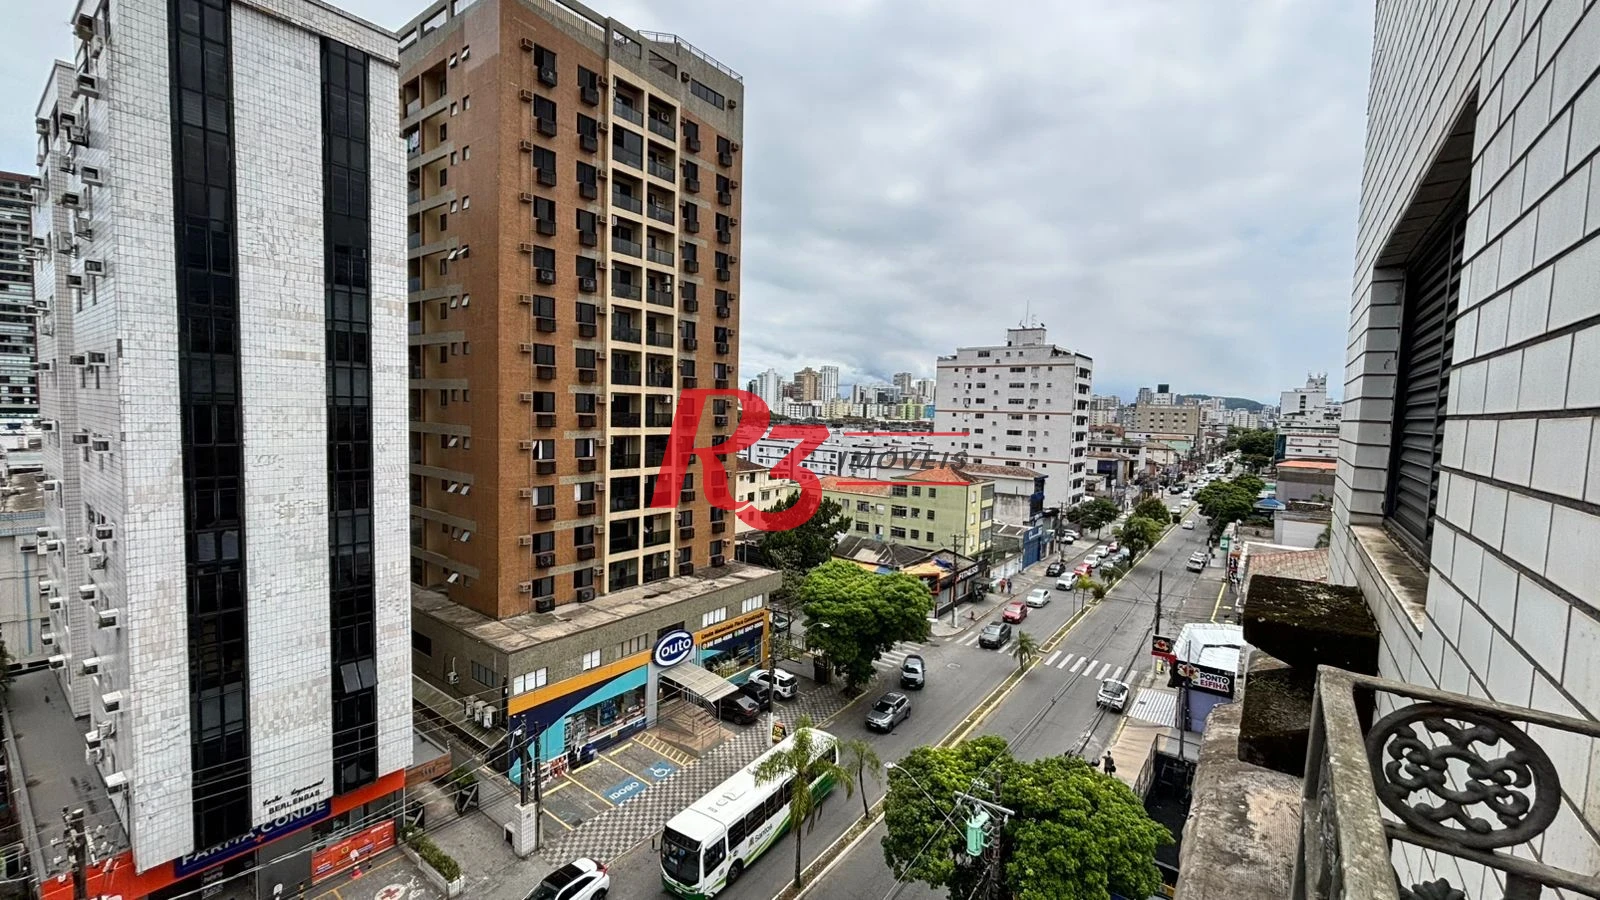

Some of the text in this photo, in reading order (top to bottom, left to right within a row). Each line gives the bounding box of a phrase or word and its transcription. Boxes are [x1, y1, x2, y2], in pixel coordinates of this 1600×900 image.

[655, 630, 692, 667] Couto
[1200, 672, 1229, 685] PONTO
[1200, 679, 1228, 692] ESFIHA
[608, 781, 640, 801] IDOSO
[261, 801, 327, 833] CONDE
[754, 823, 774, 843] Santos
